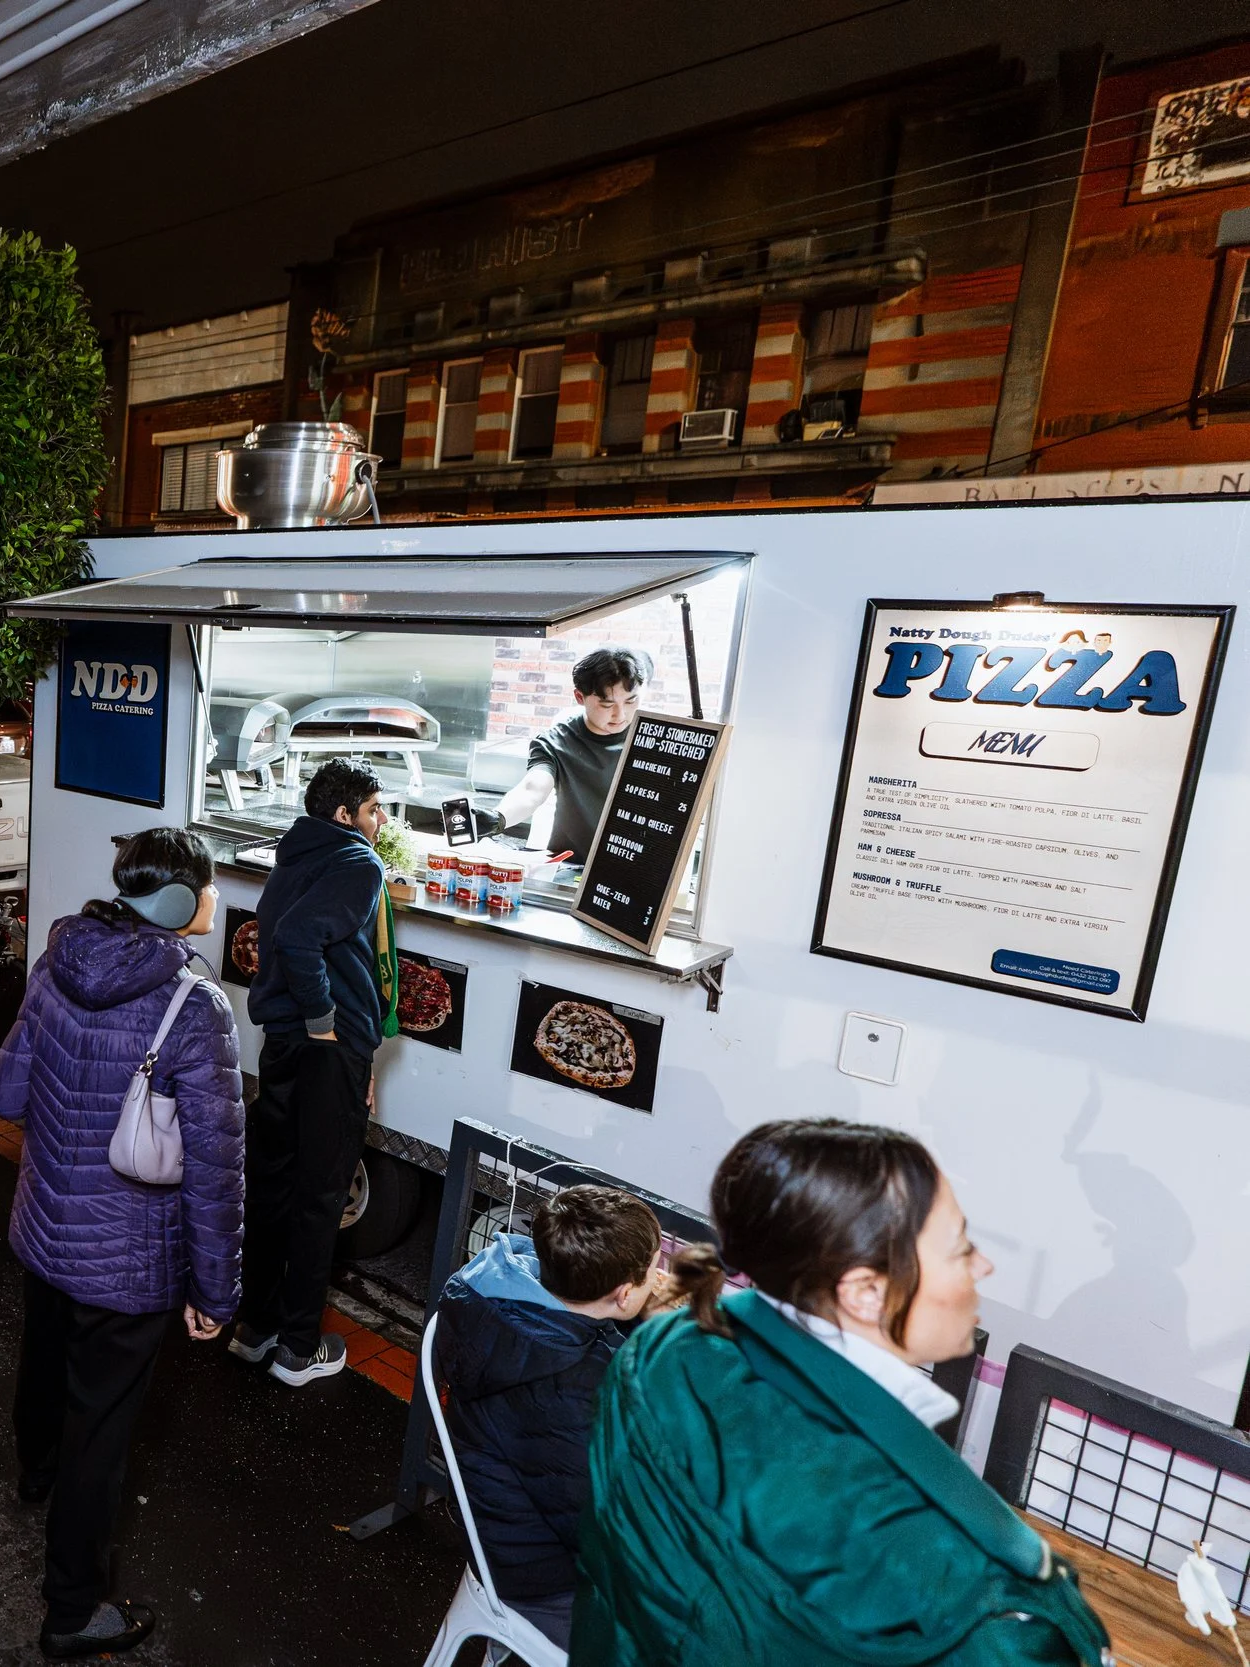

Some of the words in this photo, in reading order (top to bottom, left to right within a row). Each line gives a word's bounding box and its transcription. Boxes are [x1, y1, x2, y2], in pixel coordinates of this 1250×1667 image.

[889, 627, 935, 639] Natty
[939, 628, 993, 642] Dough
[71, 661, 158, 702] NDD
[873, 641, 1187, 716] PIZZA
[92, 702, 113, 712] PIZZA
[115, 704, 154, 716] CATERING
[638, 722, 664, 737] FRESH
[666, 727, 716, 748] STONEBAKED
[634, 735, 705, 761] HAND-STRETCHED
[968, 730, 1046, 758] MENU
[682, 770, 698, 783] $20
[869, 776, 917, 788] MARGHERITA
[625, 784, 660, 801] SOPRESSA
[678, 802, 688, 813] 25
[955, 798, 987, 807] SLATHERED
[616, 808, 630, 821] HAM
[632, 815, 645, 825] AND
[648, 818, 674, 835] CHEESE
[863, 810, 901, 821] SOPRESSA
[860, 828, 886, 837] PARMESAN
[863, 820, 895, 830] TRADITIONAL
[899, 826, 922, 834] ITALIAN
[945, 832, 966, 840] SALAMI
[609, 833, 644, 854] MUSHROOM
[858, 842, 872, 851] HAM
[886, 847, 916, 858] CHEESE
[606, 843, 635, 862] TRUFFLE
[856, 853, 878, 863] CLASSIC
[978, 873, 999, 882] TOPPED
[1021, 879, 1052, 888] PARMESAN
[1070, 886, 1086, 894] SALT
[853, 872, 891, 884] MUSHROOM
[906, 881, 942, 893] TRUFFLE
[596, 883, 630, 905] COKE-ZERO
[850, 890, 866, 898] OLIVE
[593, 895, 611, 911] WATER
[647, 906, 652, 915] 3
[851, 883, 870, 891] CREAMY
[873, 887, 895, 895] TRUFFLE
[915, 893, 935, 901] TOPPED
[1023, 912, 1042, 920] LATTE
[1060, 918, 1080, 926] EXTRA
[1084, 921, 1108, 931] VIRGIN
[643, 917, 649, 925] 3
[1081, 968, 1111, 977] Catering?
